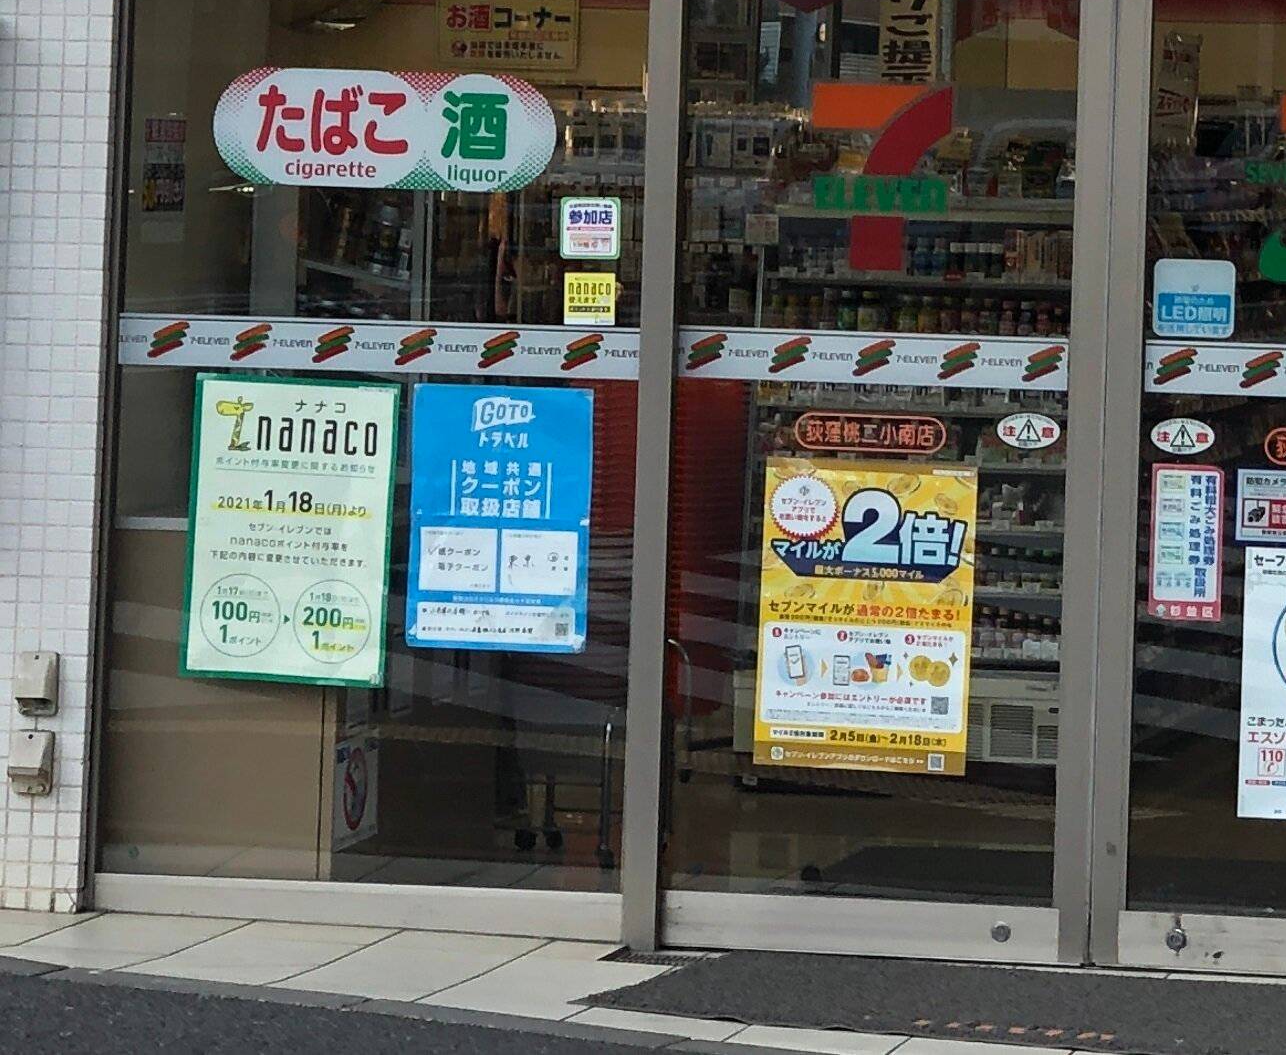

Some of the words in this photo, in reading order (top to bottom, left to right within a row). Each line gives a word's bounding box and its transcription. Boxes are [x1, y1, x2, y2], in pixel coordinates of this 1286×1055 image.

[446, 3, 571, 29] お酒コーナー
[256, 84, 409, 156] たばこ
[441, 90, 510, 160] 酒
[285, 158, 377, 179] cigarette
[446, 166, 507, 186] liquor
[568, 209, 613, 225] 参加店
[568, 282, 611, 296] nanaco
[294, 399, 347, 414] ナナコ
[256, 415, 378, 457] nanaco
[478, 431, 530, 449] トラベル
[804, 419, 936, 447] 荻窪桃二小南店
[1157, 432, 1170, 443] 注
[460, 459, 543, 478] 地域共通
[461, 477, 542, 497] クーポン
[217, 489, 367, 518] 2021年1月18日(月)より
[460, 497, 542, 519] 取扱店舗
[768, 599, 961, 622] セブンマイルが通常の2倍たまる!
[219, 624, 262, 647] 1ポイント
[311, 630, 355, 652] 1ポイント
[1261, 750, 1283, 763] 110
